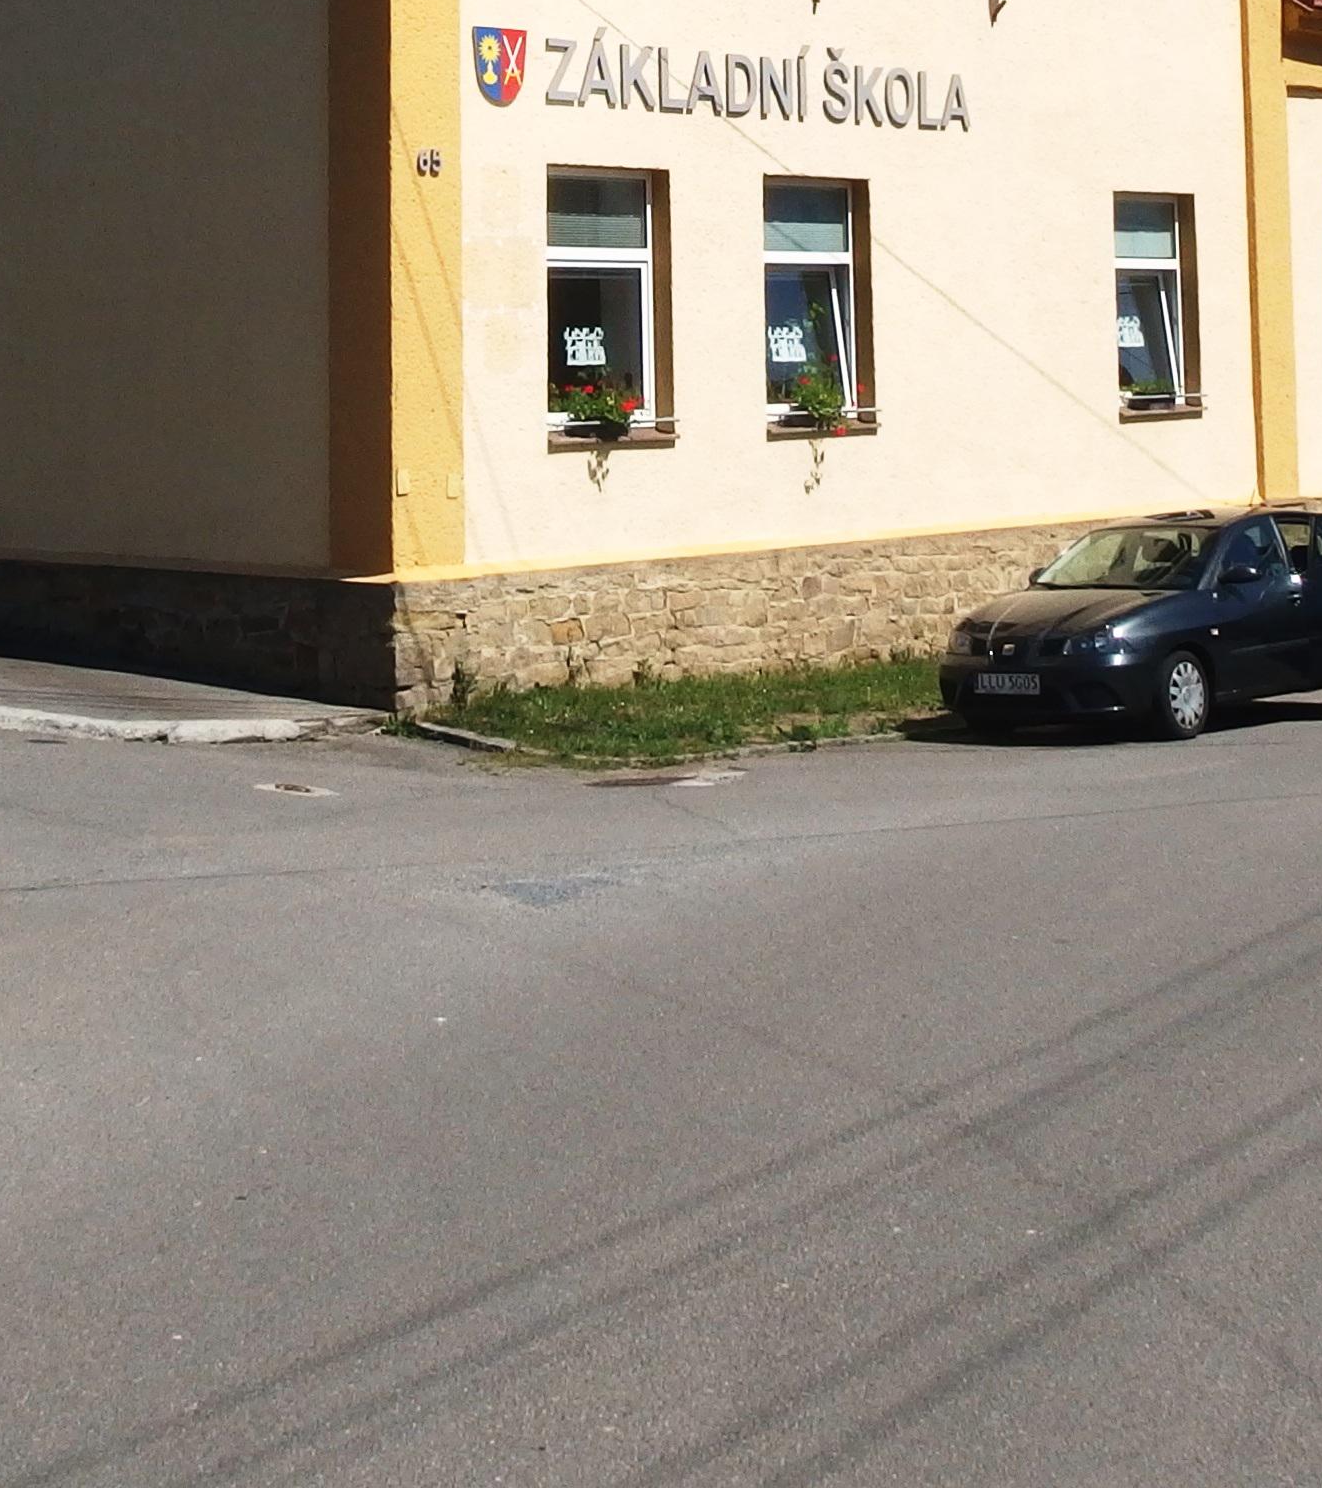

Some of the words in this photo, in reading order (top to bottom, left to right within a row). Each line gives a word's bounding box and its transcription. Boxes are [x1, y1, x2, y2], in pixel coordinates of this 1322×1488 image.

[545, 26, 810, 123] ZÁKLADNÍ
[822, 46, 971, 133] ŠKOLA
[980, 674, 1005, 690] LLU
